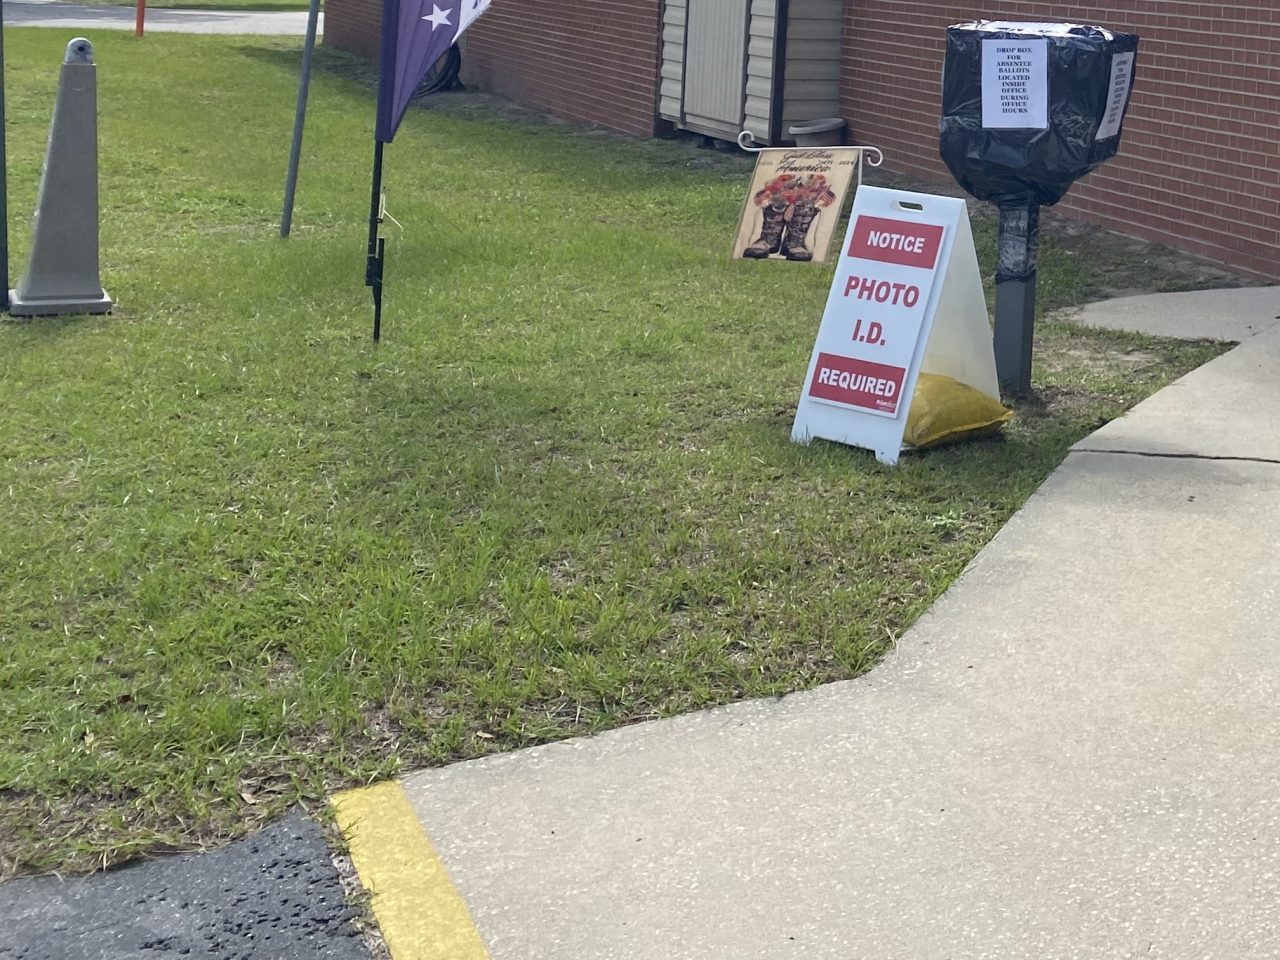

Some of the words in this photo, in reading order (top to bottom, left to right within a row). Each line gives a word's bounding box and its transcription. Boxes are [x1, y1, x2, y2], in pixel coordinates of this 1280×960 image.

[867, 230, 925, 254] NOTICE
[844, 275, 920, 308] PHOTO
[851, 319, 886, 346] I.D.
[818, 367, 896, 398] REQUIRED
